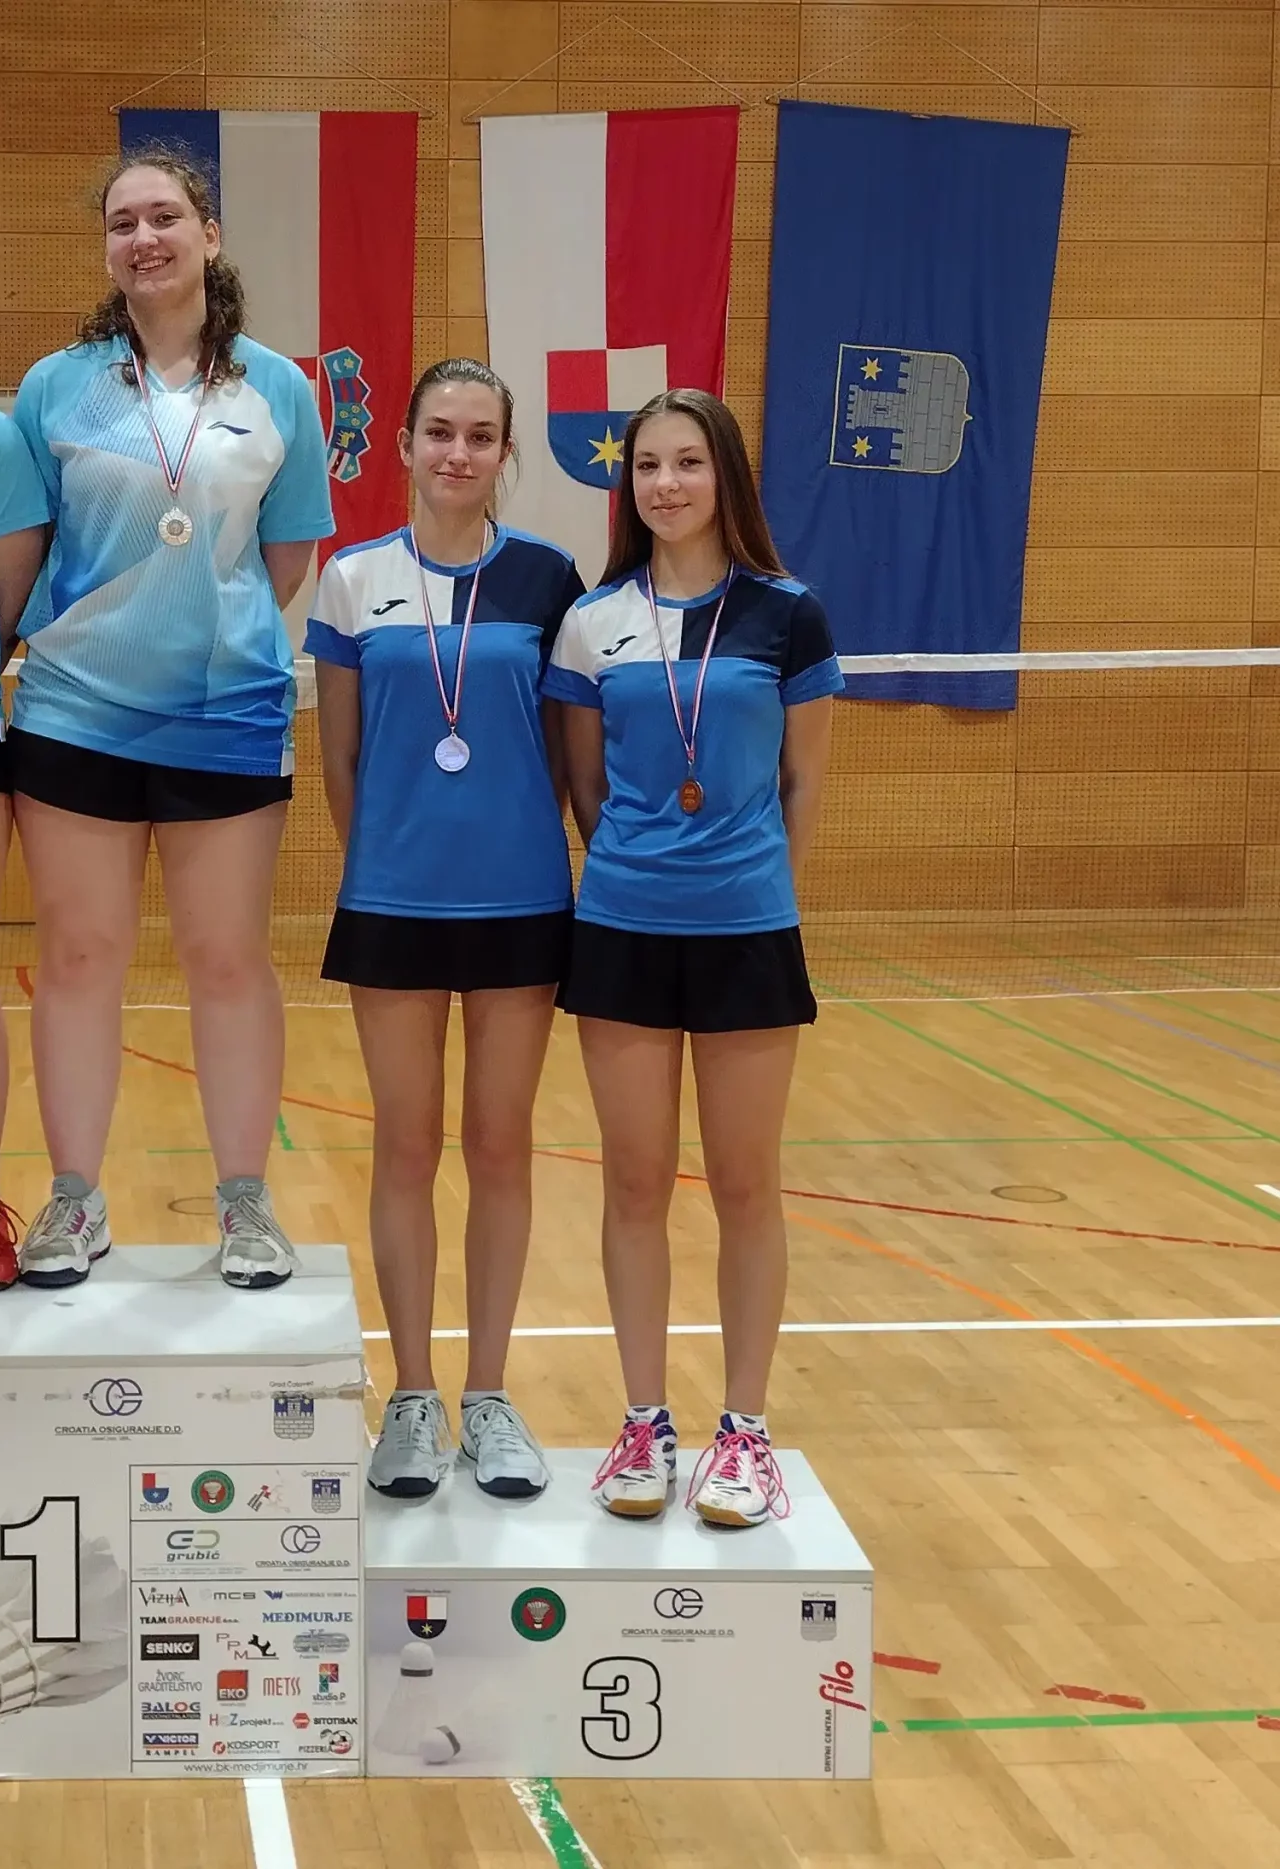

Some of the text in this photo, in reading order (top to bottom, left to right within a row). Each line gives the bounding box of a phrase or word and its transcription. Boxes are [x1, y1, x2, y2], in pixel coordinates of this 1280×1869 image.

[99, 1425, 161, 1433] OSIGURANJE
[166, 1551, 220, 1562] grubić
[255, 1560, 287, 1568] CROATIA
[0, 1496, 80, 1643] 1
[819, 1661, 867, 1711] filo
[220, 1689, 246, 1698] EKO
[340, 1692, 346, 1700] P
[581, 1656, 662, 1760] 3
[240, 1716, 271, 1727] projekt
[314, 1717, 358, 1725] SITOTISAK
[158, 1735, 197, 1743] VICTOR
[824, 1709, 832, 1772] DRVNI CENTAR
[227, 1740, 279, 1749] KOSPORT
[298, 1746, 332, 1754] PIZZERIA
